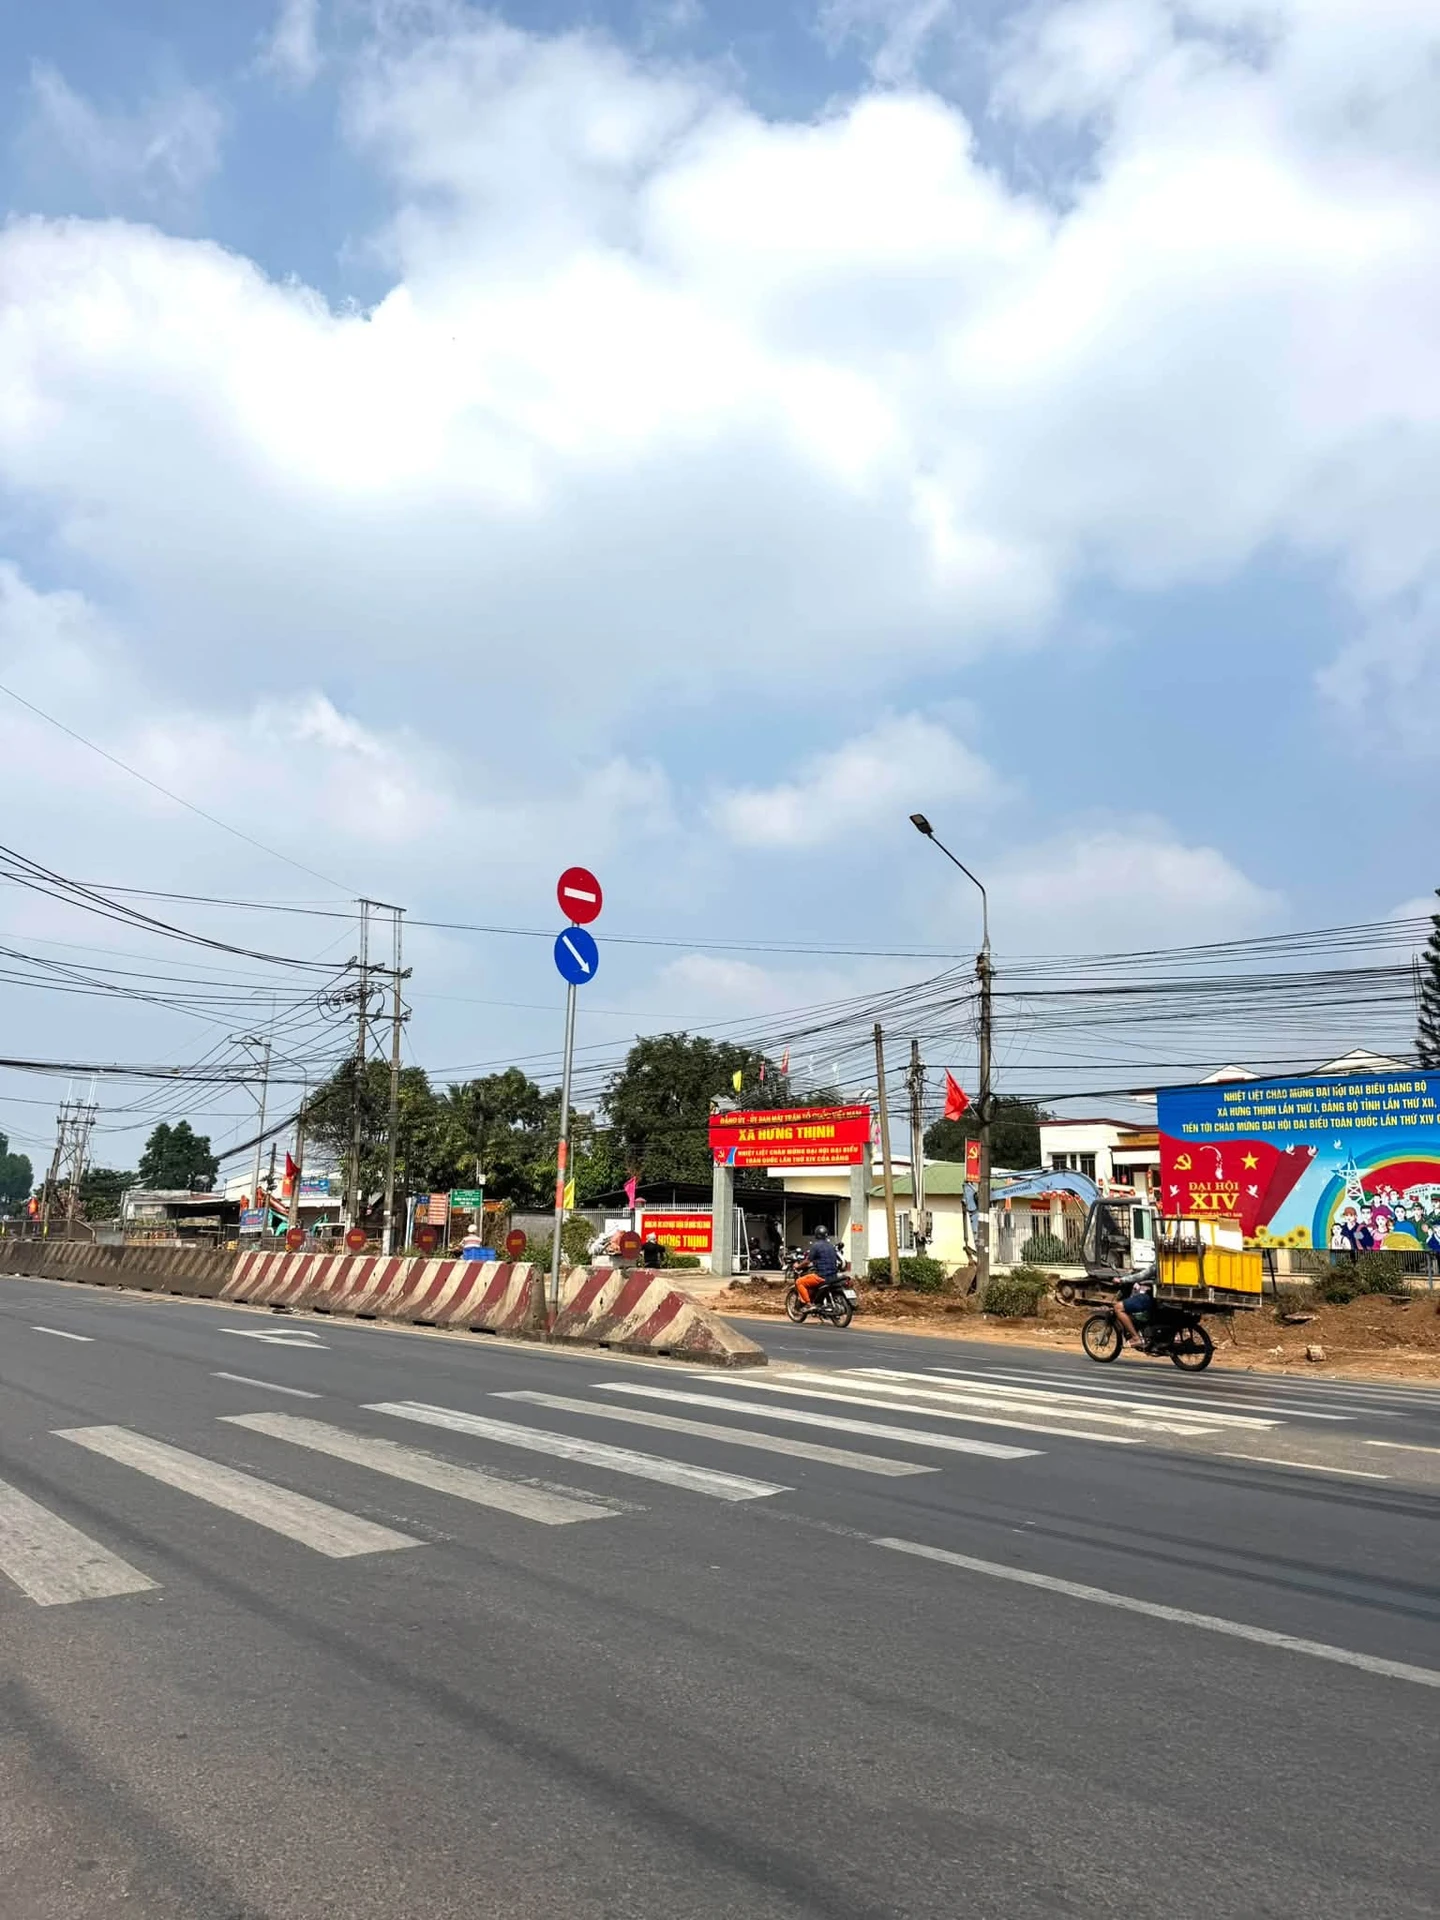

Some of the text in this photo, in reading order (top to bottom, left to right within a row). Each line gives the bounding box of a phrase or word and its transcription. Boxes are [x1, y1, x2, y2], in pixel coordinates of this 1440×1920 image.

[1224, 1081, 1428, 1102] NHIỆT LIỆT CHÀO MỪNG ĐẠI HỘI ĐẠI BIỂU ĐẢNG BỘ
[1217, 1106, 1228, 1117] XÃ
[1230, 1106, 1252, 1116] HƯNG
[1253, 1105, 1276, 1117] THỊNH
[1297, 1102, 1312, 1113] THỨ
[1322, 1100, 1344, 1112] ĐẢNG
[1347, 1100, 1358, 1113] BỘ
[1361, 1099, 1380, 1110] TỈNH
[1402, 1097, 1420, 1109] THỨ
[1183, 1122, 1198, 1133] TIẾN
[1200, 1121, 1212, 1132] TỚI
[1215, 1121, 1234, 1132] CHÀO
[1237, 1120, 1260, 1131] MỪNG
[1262, 1120, 1276, 1132] ĐẠI
[1278, 1119, 1292, 1131] HỘI
[1294, 1119, 1306, 1130] ĐẠI
[1309, 1116, 1328, 1128] BIỂU
[1331, 1116, 1352, 1127] TOÀN
[1355, 1114, 1378, 1127] QUỐC
[1400, 1113, 1418, 1125] THỨ
[1420, 1114, 1434, 1124] XIV
[738, 1125, 834, 1141] XÃ HƯNG THỊNH
[1188, 1180, 1239, 1193] ĐẠI HỘI
[1190, 1193, 1240, 1210] XIV
[682, 1235, 708, 1250] THỊNH
